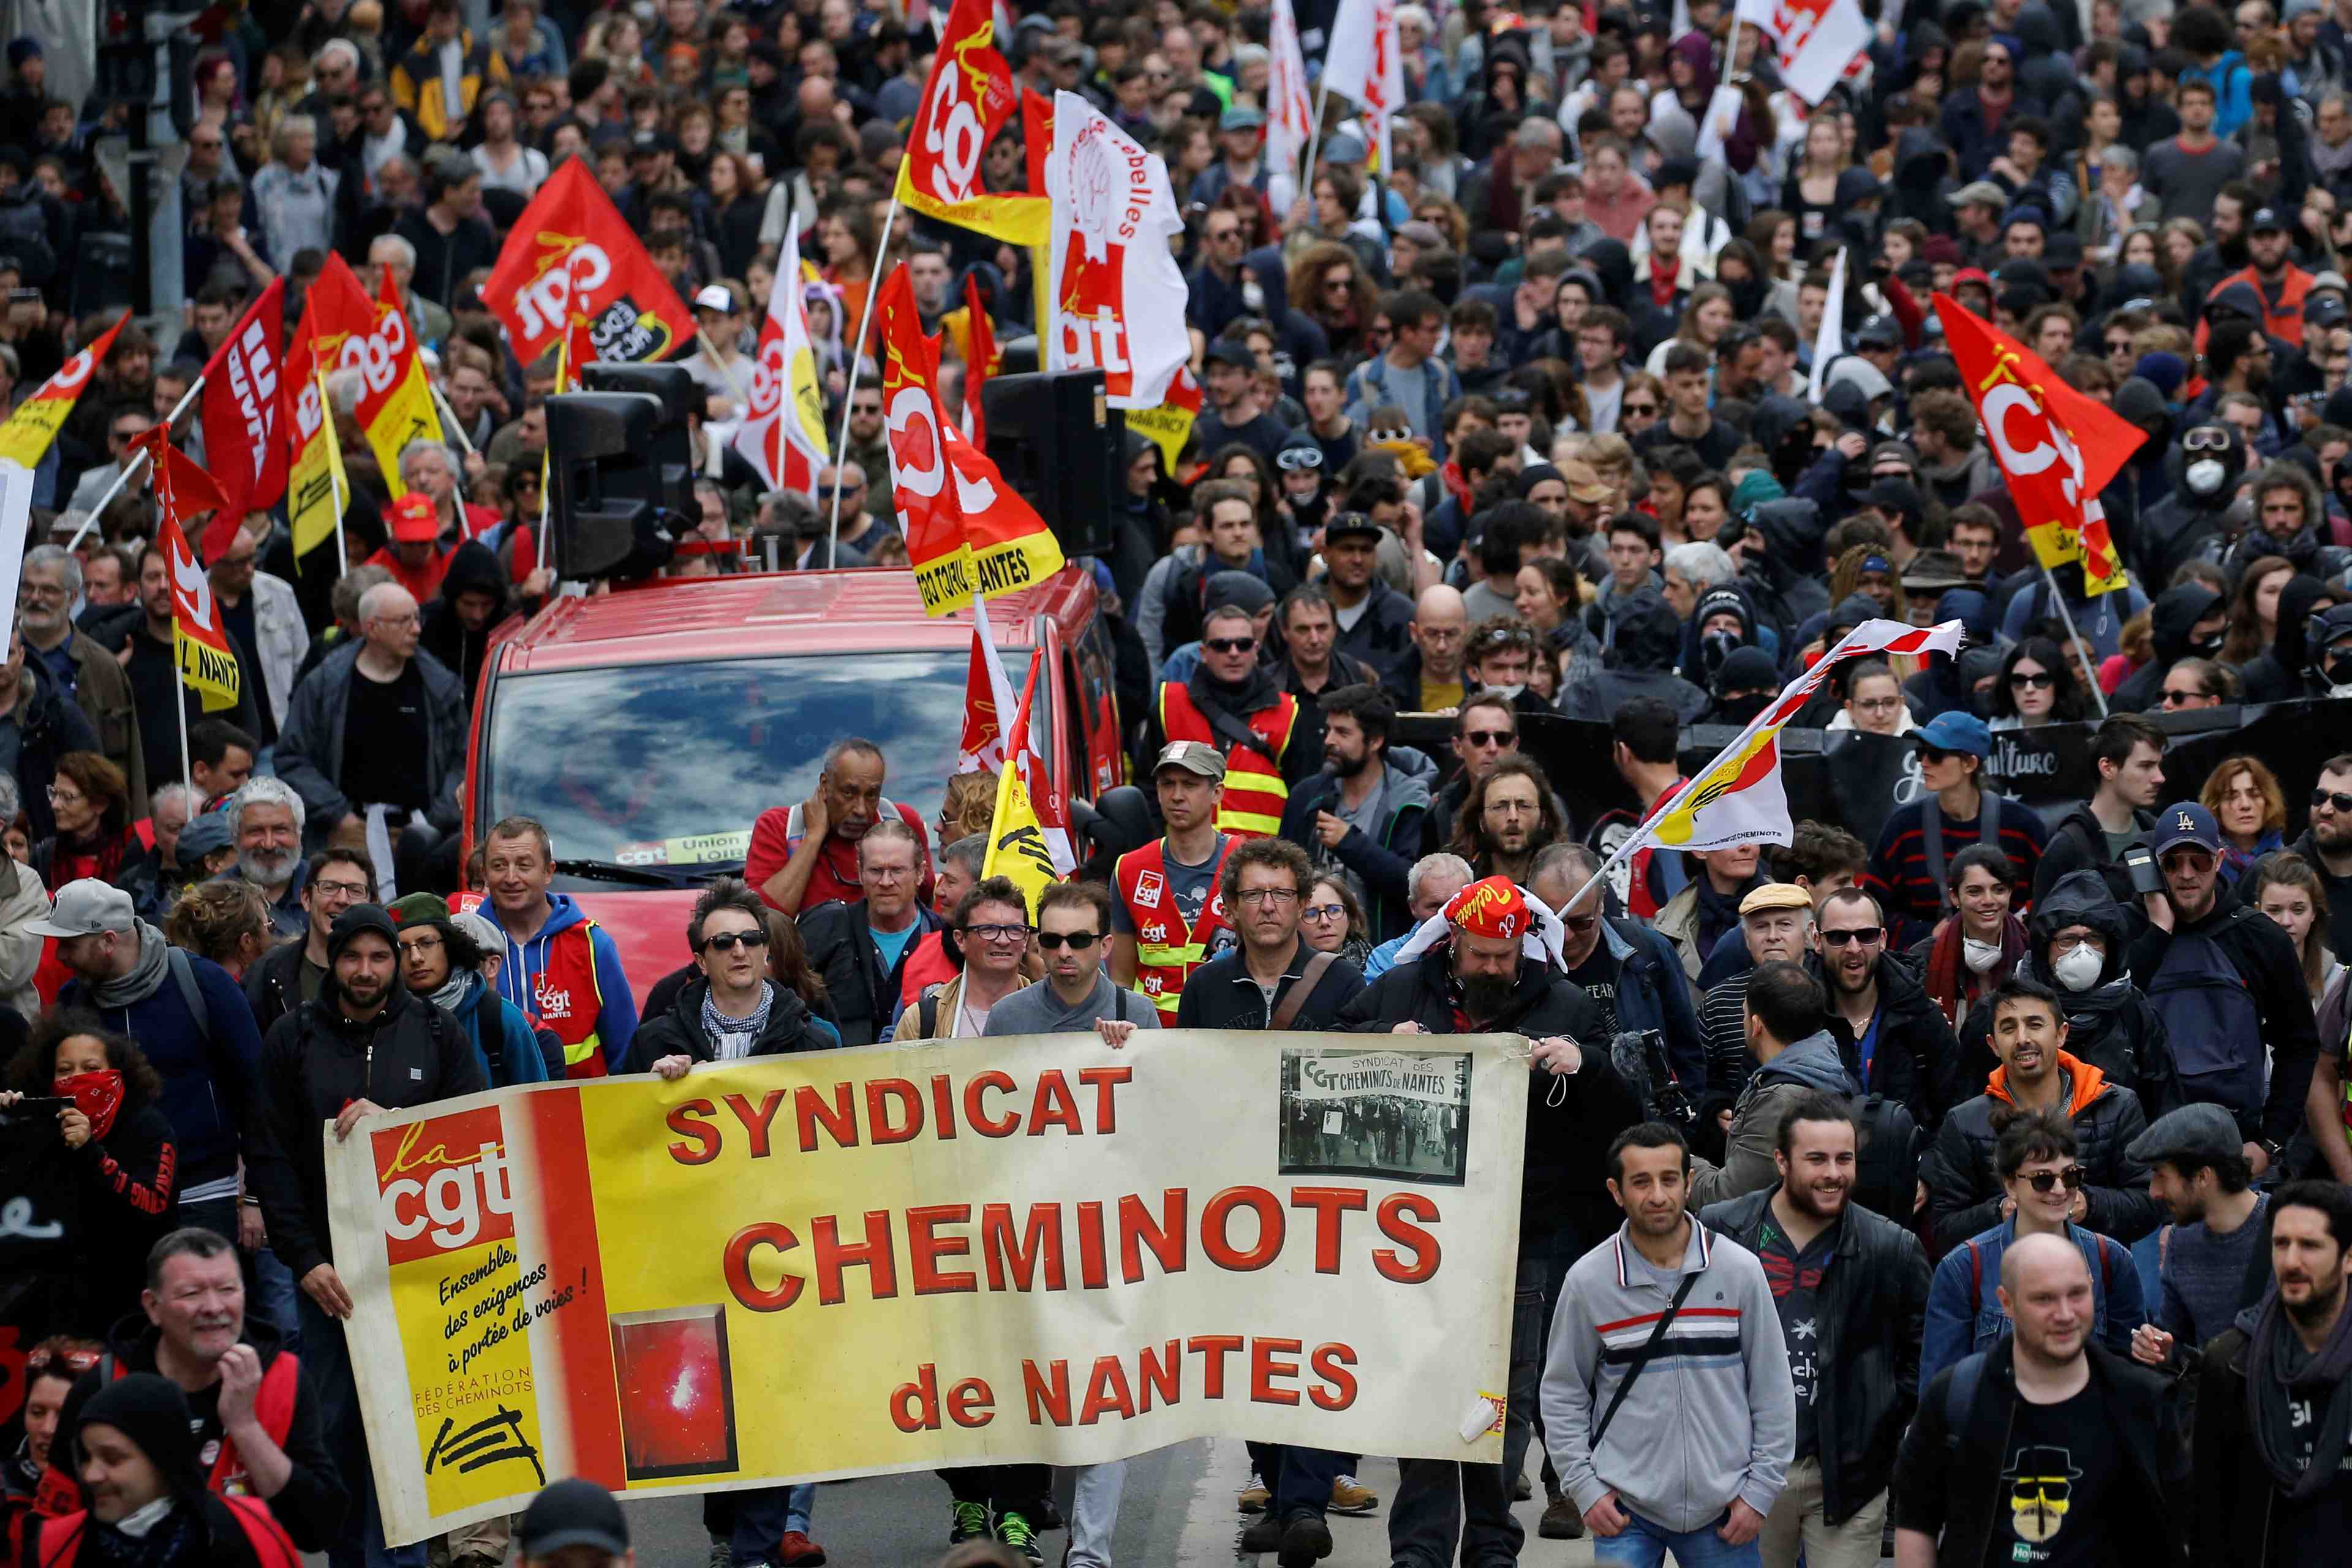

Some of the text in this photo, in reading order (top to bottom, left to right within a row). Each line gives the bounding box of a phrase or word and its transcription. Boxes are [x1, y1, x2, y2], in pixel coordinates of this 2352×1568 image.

[978, 548, 1030, 594] ANTES
[2177, 811, 2195, 831] LA
[682, 836, 740, 850] Union
[1137, 886, 1159, 901] cgt
[1141, 923, 1167, 942] cgt
[541, 989, 571, 1012] cgt
[1145, 976, 1163, 993] cgt
[1585, 982, 1615, 998] FEAR
[542, 1011, 571, 1020] NANTES
[1303, 1060, 1340, 1091] CGT
[1393, 1077, 1402, 1089] DE
[1401, 1072, 1446, 1095] NANTES
[1352, 1056, 1434, 1072] SYNDICAT DES
[665, 1065, 1133, 1166] SYNDICAT
[382, 1121, 505, 1182] la
[380, 1141, 514, 1248] cgt
[723, 1185, 1442, 1313] CHEMINOTS
[439, 1244, 517, 1306] Ensemble,
[444, 1263, 548, 1340] des exigences
[448, 1353, 460, 1373] à
[462, 1322, 510, 1375] portée
[512, 1308, 532, 1333] de
[535, 1285, 574, 1318] voies
[415, 1366, 530, 1404] FÉDÉRATION
[417, 1380, 533, 1419] DES CHEMINOTS
[889, 1335, 1359, 1433] de NANTES
[2013, 1548, 2051, 1560] Homer
